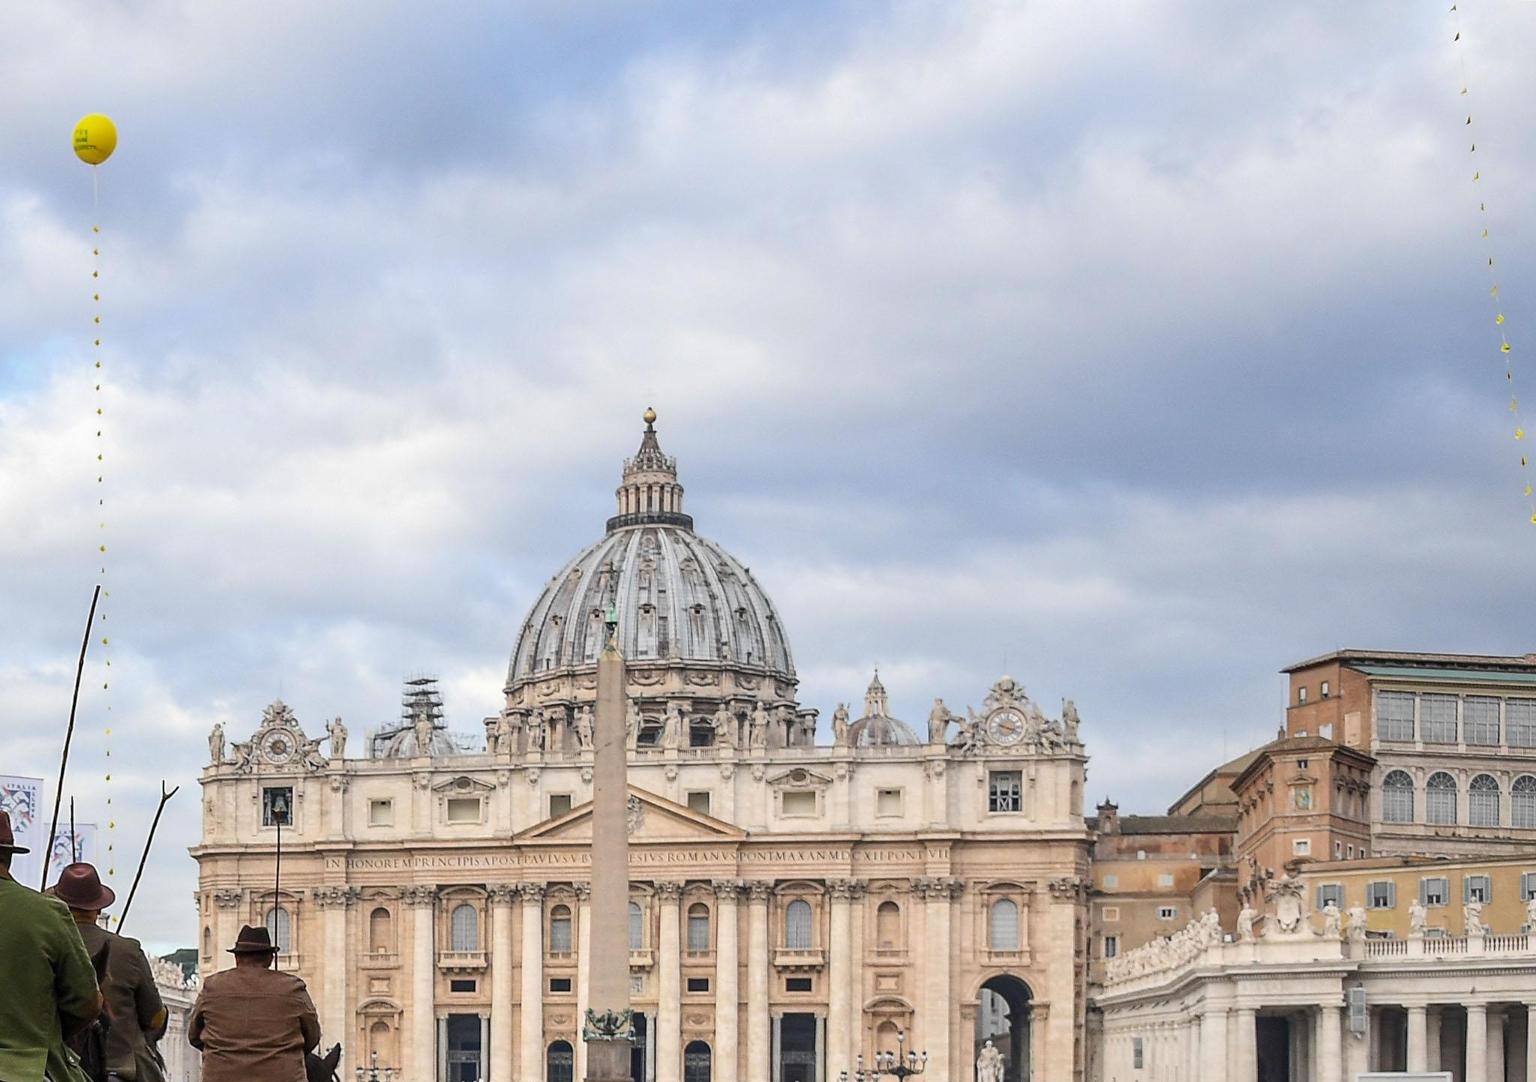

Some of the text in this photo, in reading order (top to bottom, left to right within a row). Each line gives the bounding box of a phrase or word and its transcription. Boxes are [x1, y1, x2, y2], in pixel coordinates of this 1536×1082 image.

[326, 859, 340, 868] IN
[347, 858, 411, 869] HONOREM
[415, 856, 480, 867] PRINCIPIS
[482, 855, 521, 866] APOST
[667, 851, 736, 862] ROMANVS
[776, 851, 804, 861] MAX
[888, 850, 923, 860] PONT
[928, 849, 948, 858] VII
